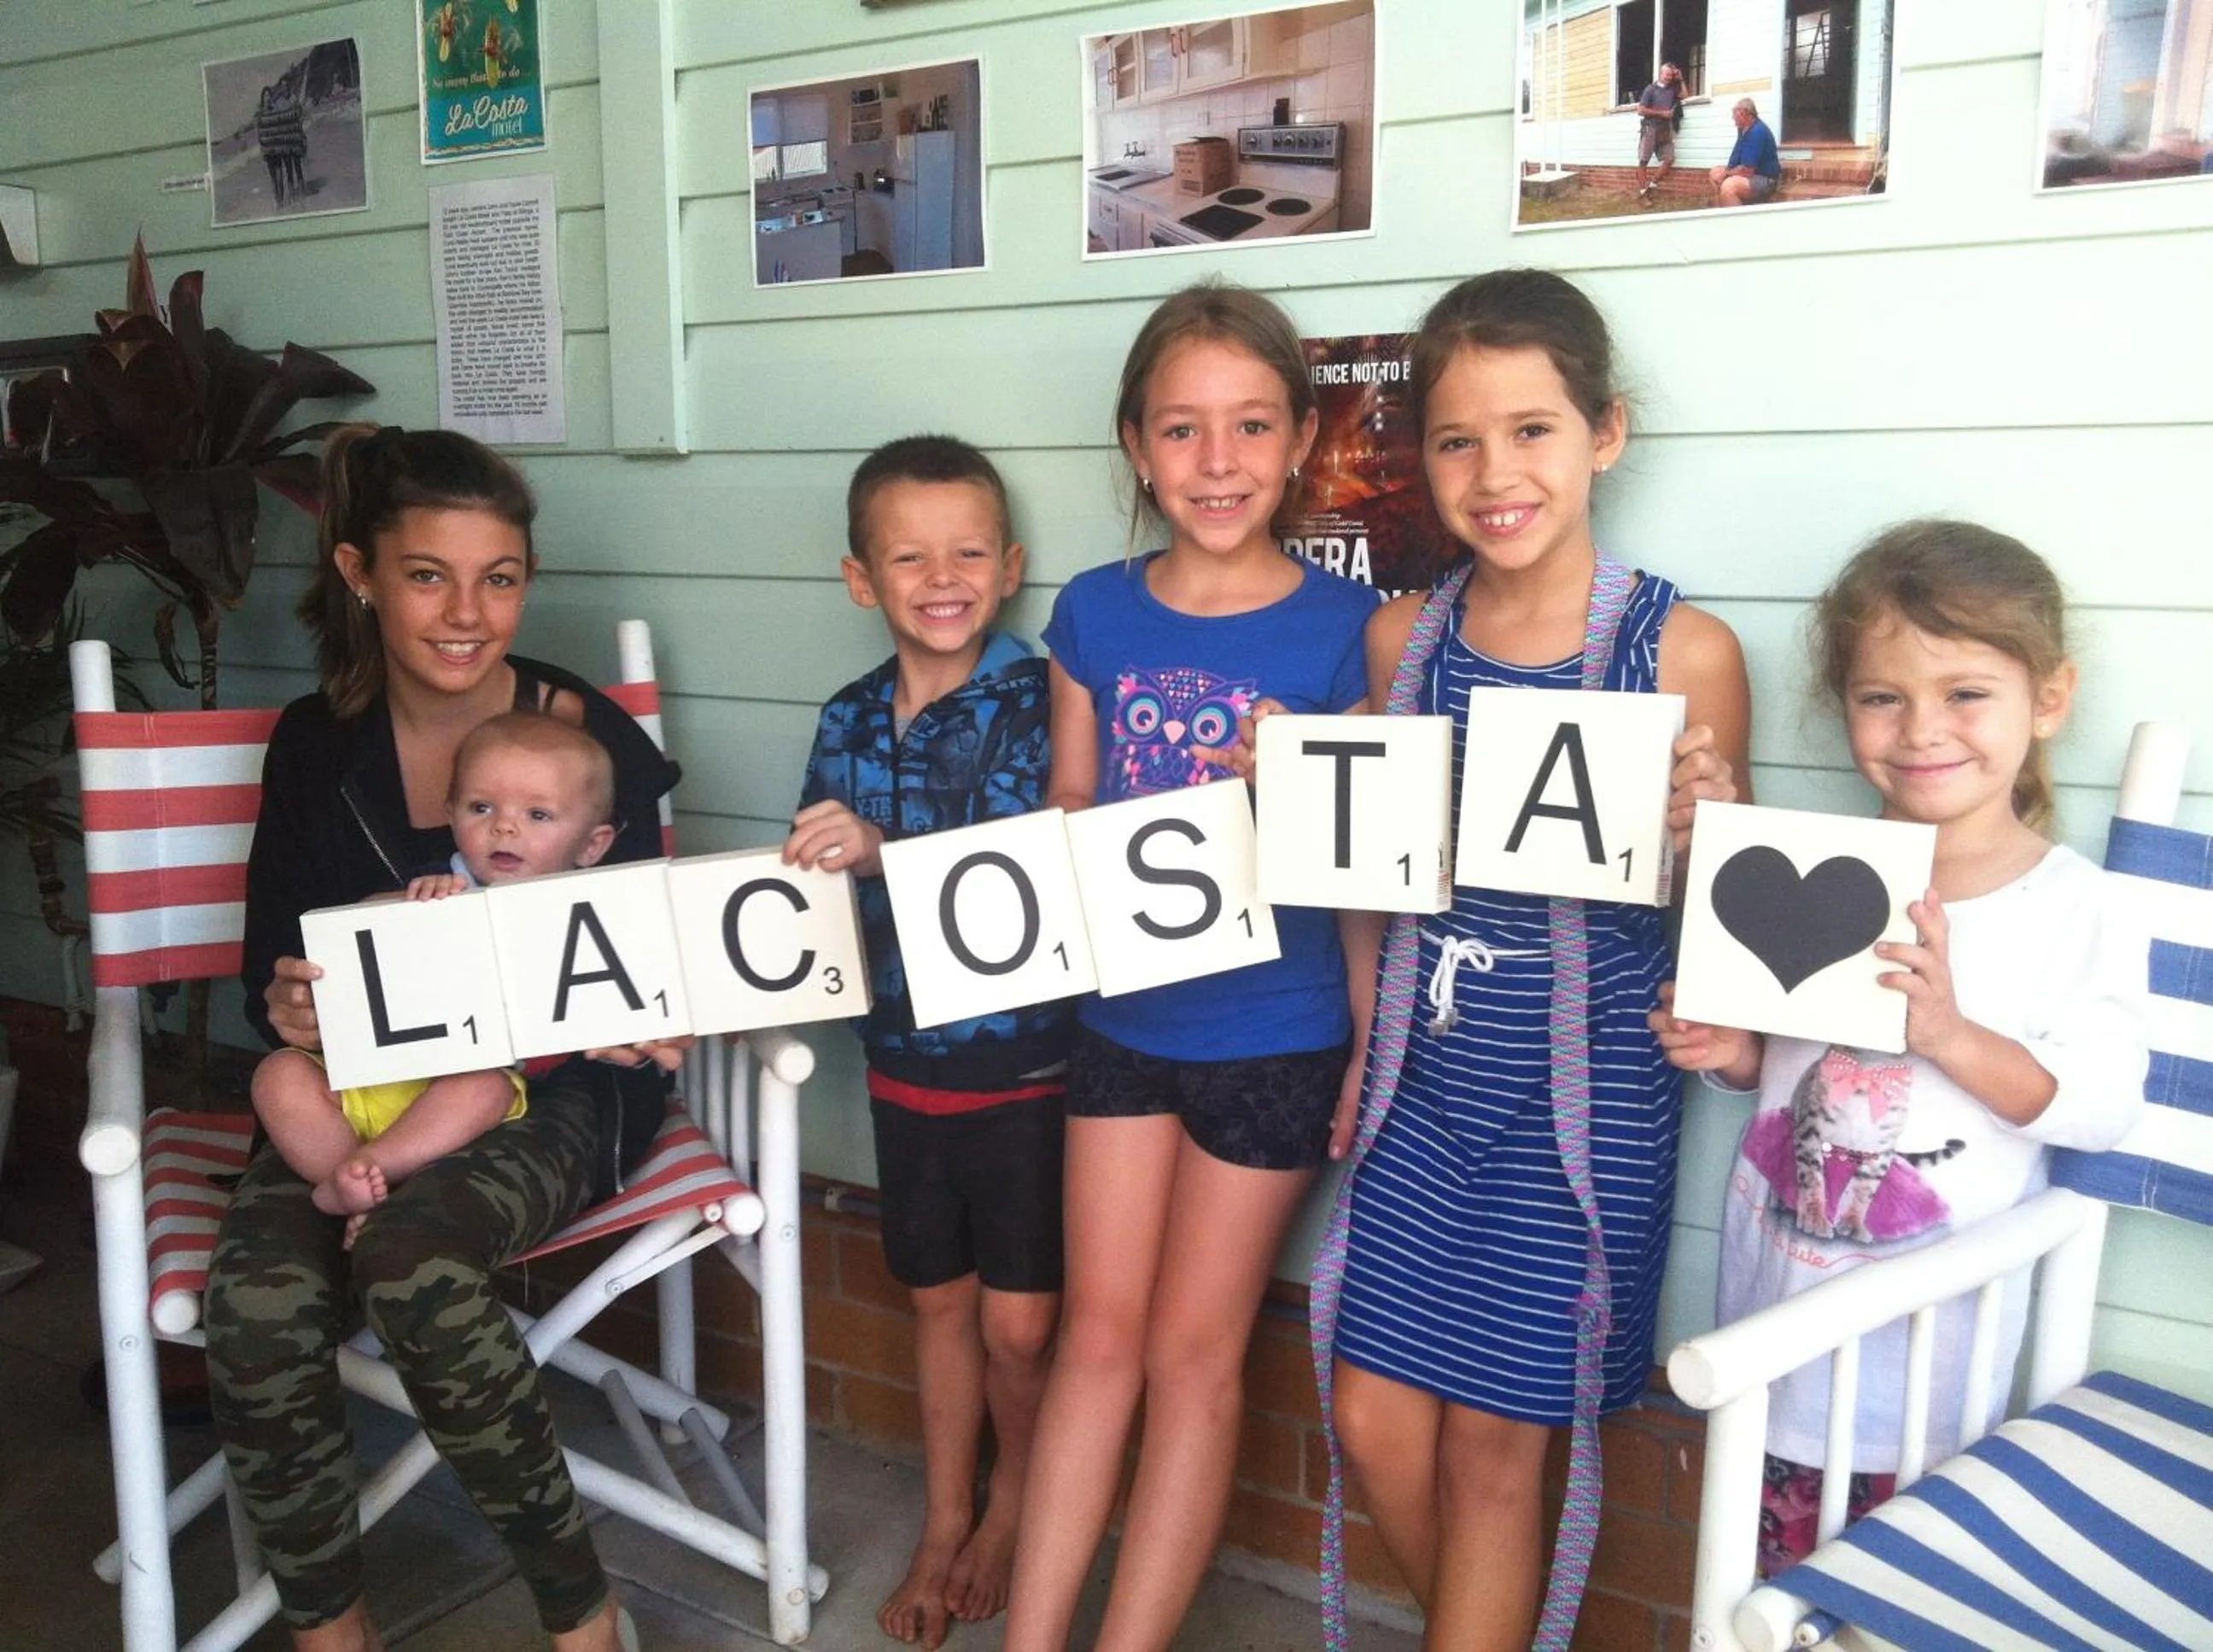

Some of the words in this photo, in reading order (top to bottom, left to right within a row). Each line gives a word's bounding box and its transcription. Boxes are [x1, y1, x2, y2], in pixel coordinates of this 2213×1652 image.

[473, 95, 528, 128] Costa
[1352, 362, 1379, 383] NOT
[1381, 361, 1399, 382] TO
